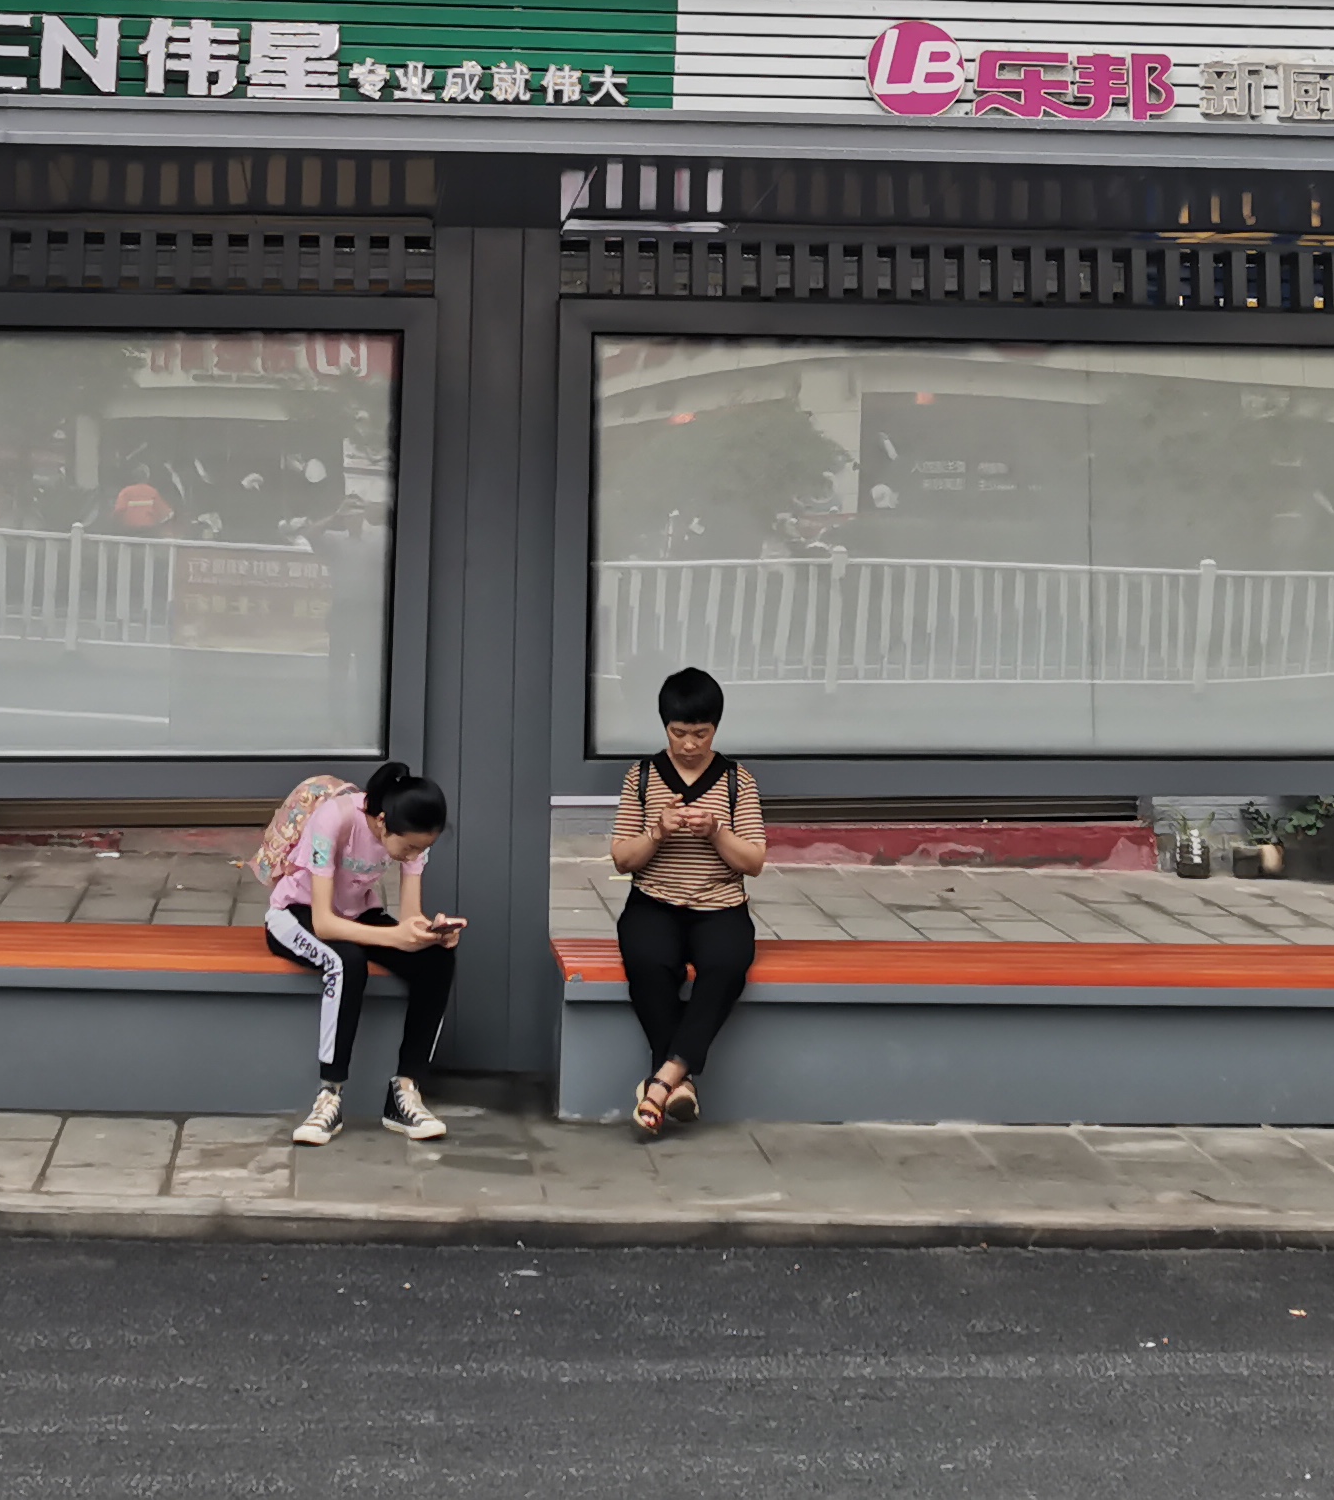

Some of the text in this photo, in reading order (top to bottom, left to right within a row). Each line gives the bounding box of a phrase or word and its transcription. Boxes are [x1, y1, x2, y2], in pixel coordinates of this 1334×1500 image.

[138, 16, 340, 100] 伟星
[348, 57, 629, 106] 专业成就伟大
[873, 26, 965, 96] LB
[972, 49, 1176, 122] 乐邦
